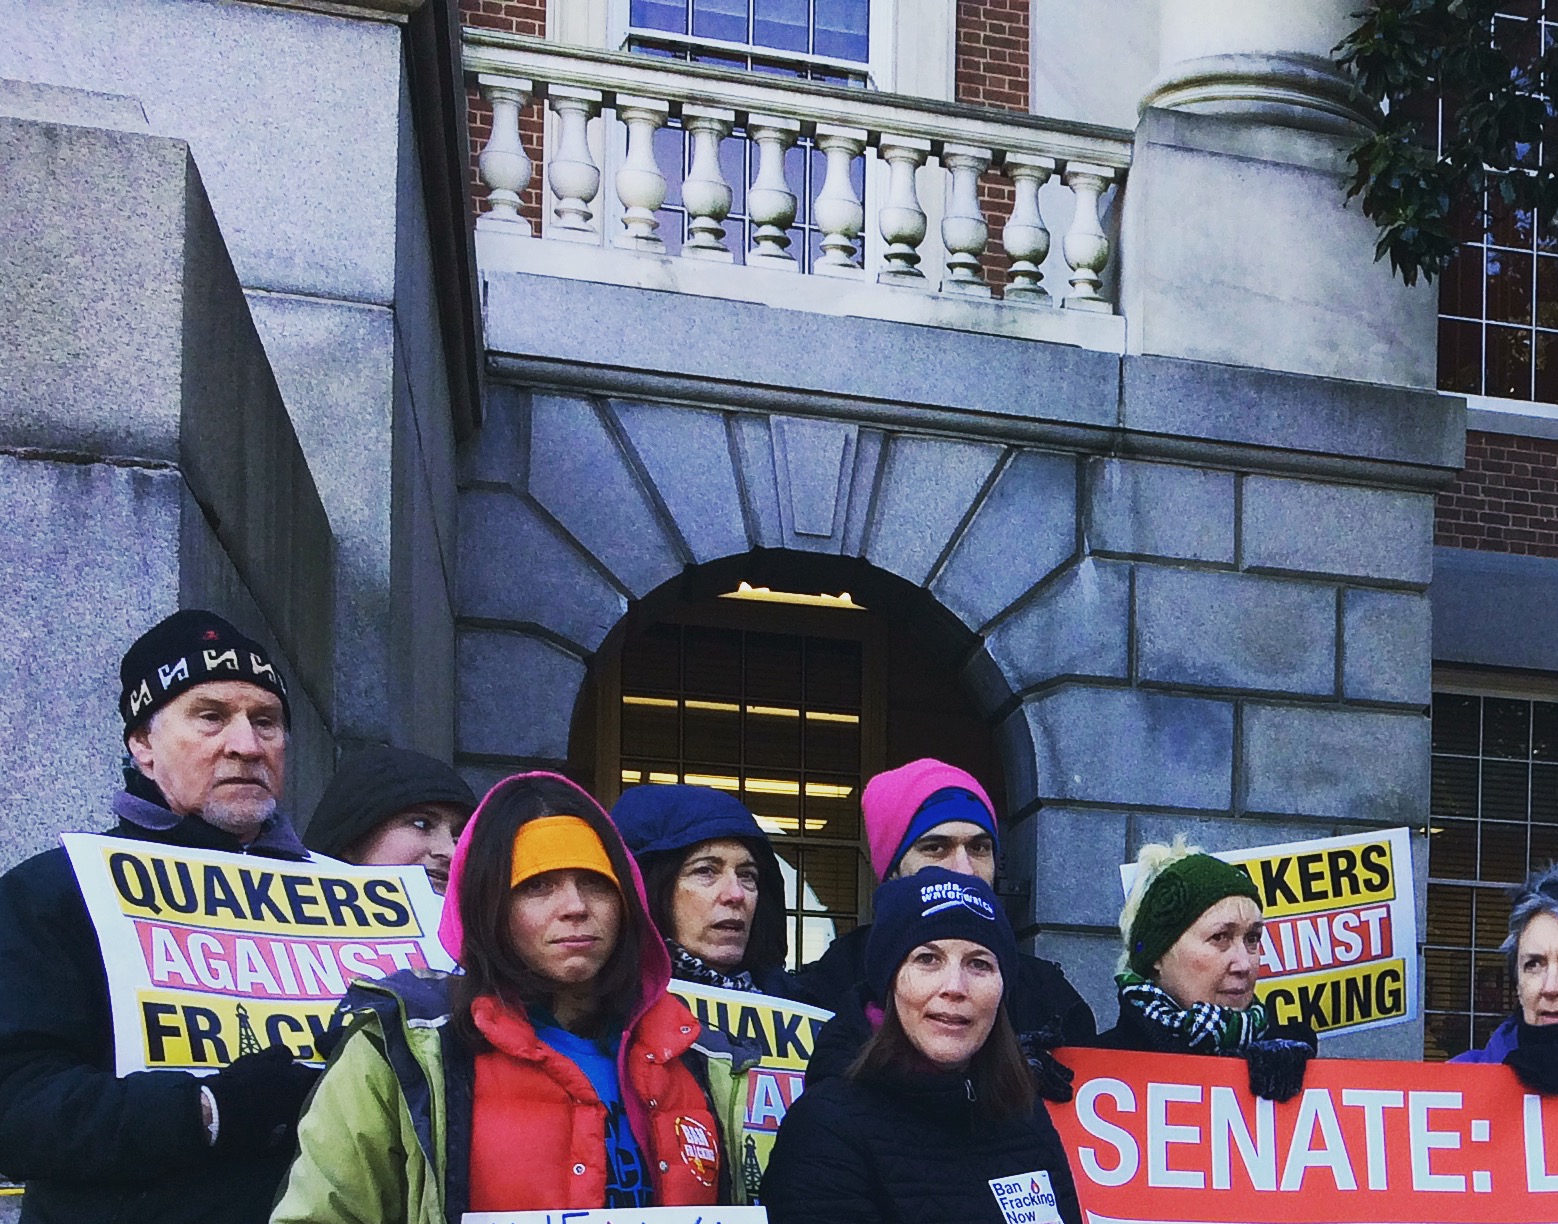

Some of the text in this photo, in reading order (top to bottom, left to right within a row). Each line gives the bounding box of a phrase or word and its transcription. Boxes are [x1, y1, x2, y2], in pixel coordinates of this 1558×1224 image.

[109, 852, 411, 930] QUAKERS
[1236, 844, 1390, 908] KERS
[1259, 908, 1388, 973] AINST
[1264, 968, 1402, 1030] CKING
[1075, 1077, 1492, 1194] SENATE:
[992, 1182, 1023, 1197] Ban
[999, 1192, 1056, 1211] Fracking
